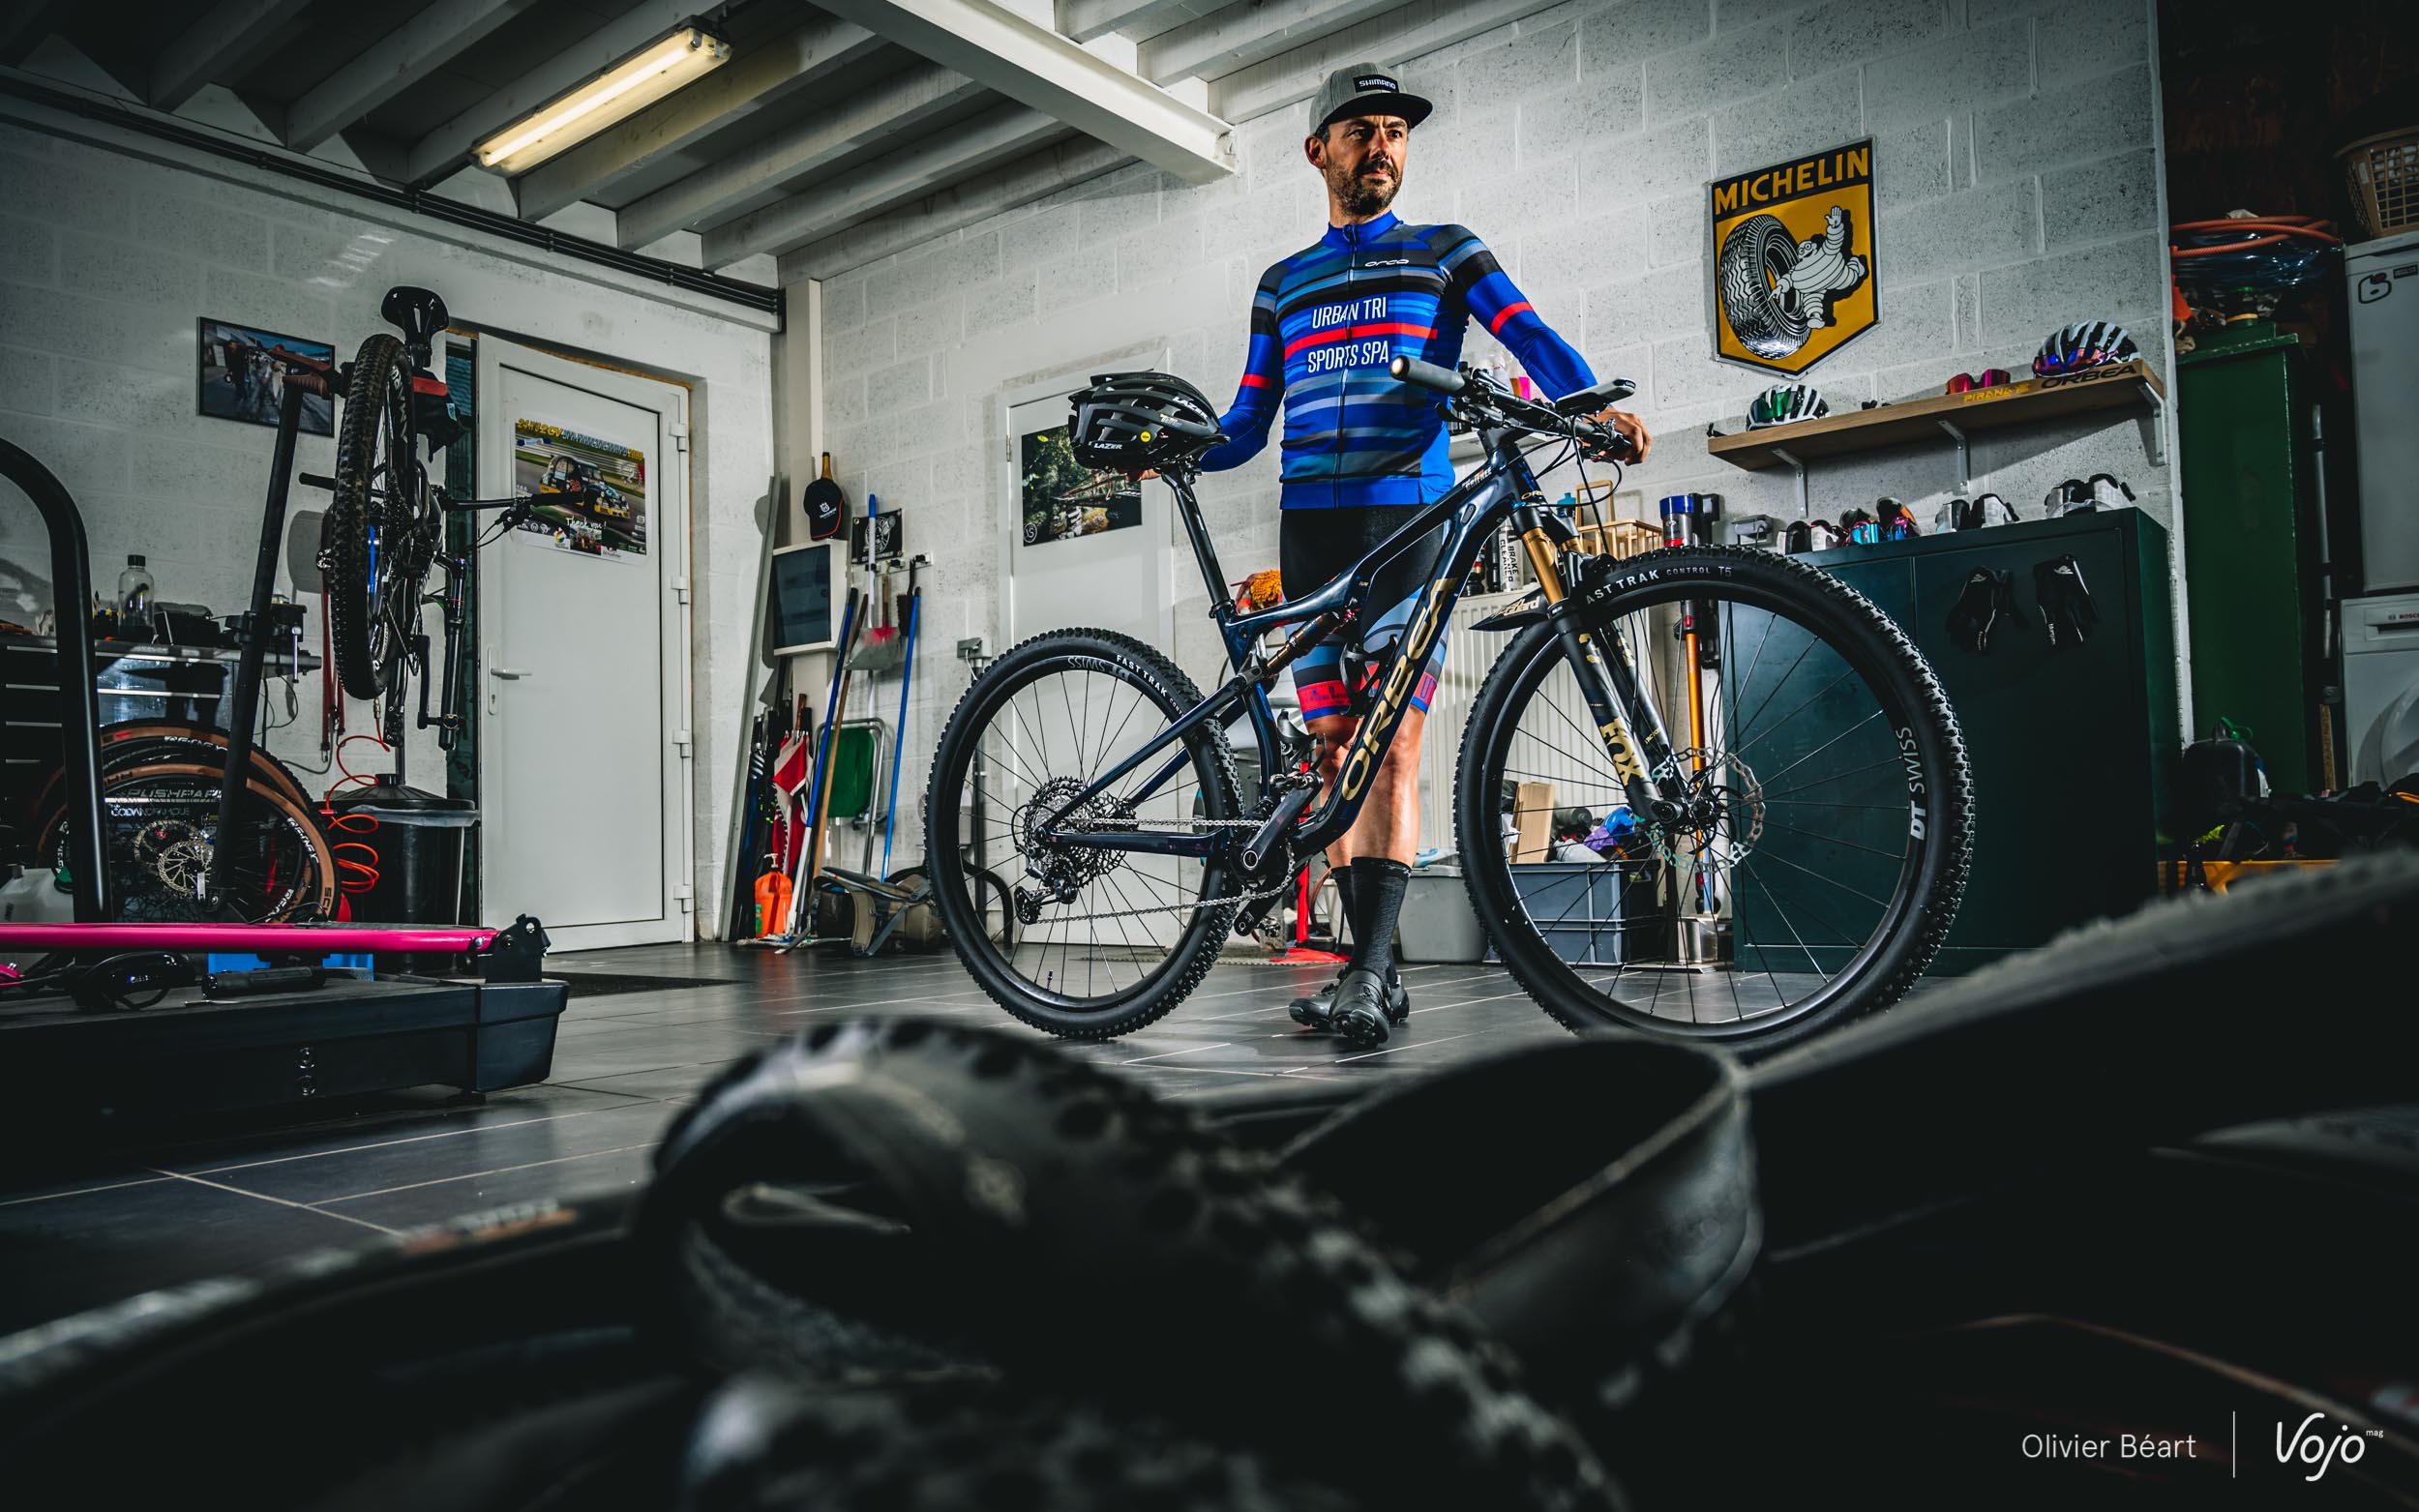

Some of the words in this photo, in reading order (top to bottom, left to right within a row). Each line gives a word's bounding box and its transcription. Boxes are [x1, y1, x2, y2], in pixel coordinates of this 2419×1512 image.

[1359, 78, 1396, 90] SHIMANO
[1715, 147, 1869, 216] MICHELIN
[1364, 258, 1410, 267] orca
[1312, 302, 1359, 329] URBAN
[1363, 296, 1387, 320] TRI
[1307, 344, 1359, 373] SPORTS
[1360, 340, 1389, 366] SPA
[2041, 365, 2137, 389] ORBEA
[1172, 396, 1209, 420] LAZER
[1500, 539, 1514, 582] CLEANER
[1508, 546, 1519, 575] BRAKE
[1586, 583, 1613, 605] AST
[1616, 569, 1660, 590] TRAK
[1666, 566, 1711, 575] CONTROL
[1718, 566, 1732, 578] T5
[1067, 656, 1105, 672] SWISS
[1117, 654, 1142, 674] FAST
[1143, 671, 1168, 697] TRAK
[1341, 578, 1459, 802] ORBEA
[1599, 717, 1645, 786] FOX
[1896, 726, 1926, 794] SWISS
[1910, 800, 1926, 841] DT
